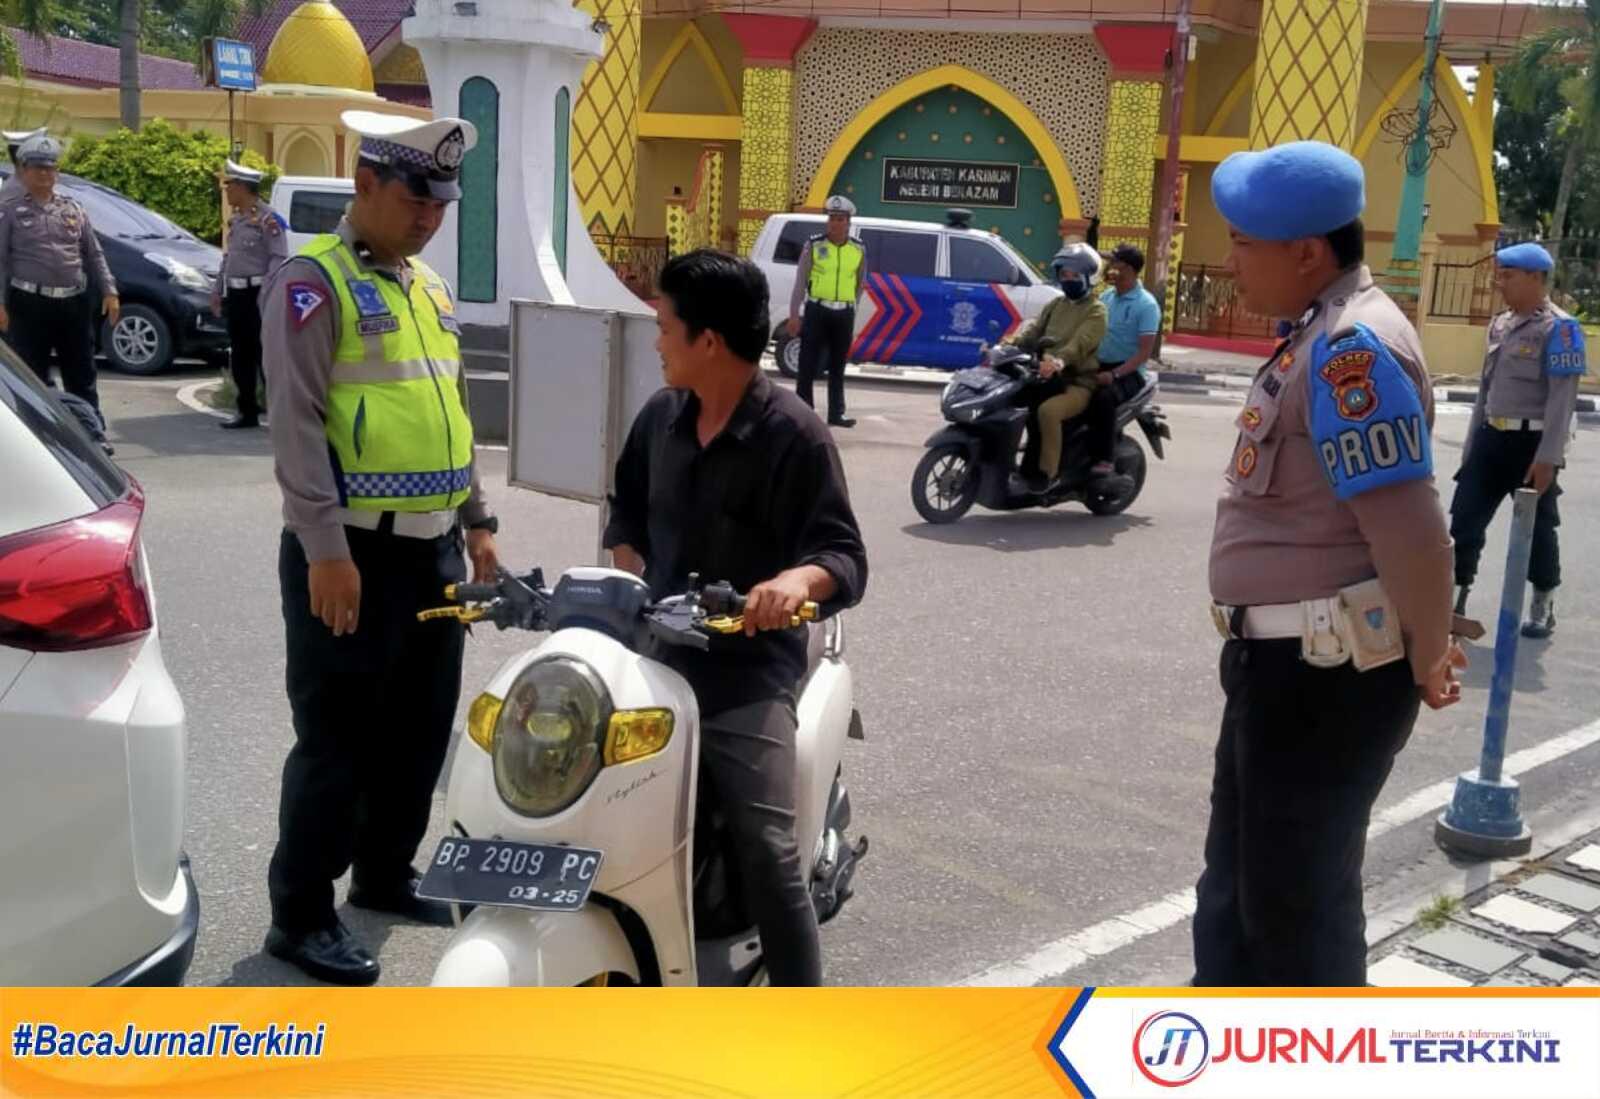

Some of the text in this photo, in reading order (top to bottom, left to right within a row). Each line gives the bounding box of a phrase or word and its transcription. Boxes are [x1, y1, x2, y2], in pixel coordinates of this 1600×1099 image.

[959, 167, 1012, 183] KARIMUN
[1321, 416, 1423, 487] PROV
[480, 847, 544, 875] 2909
[560, 853, 597, 881] PC
